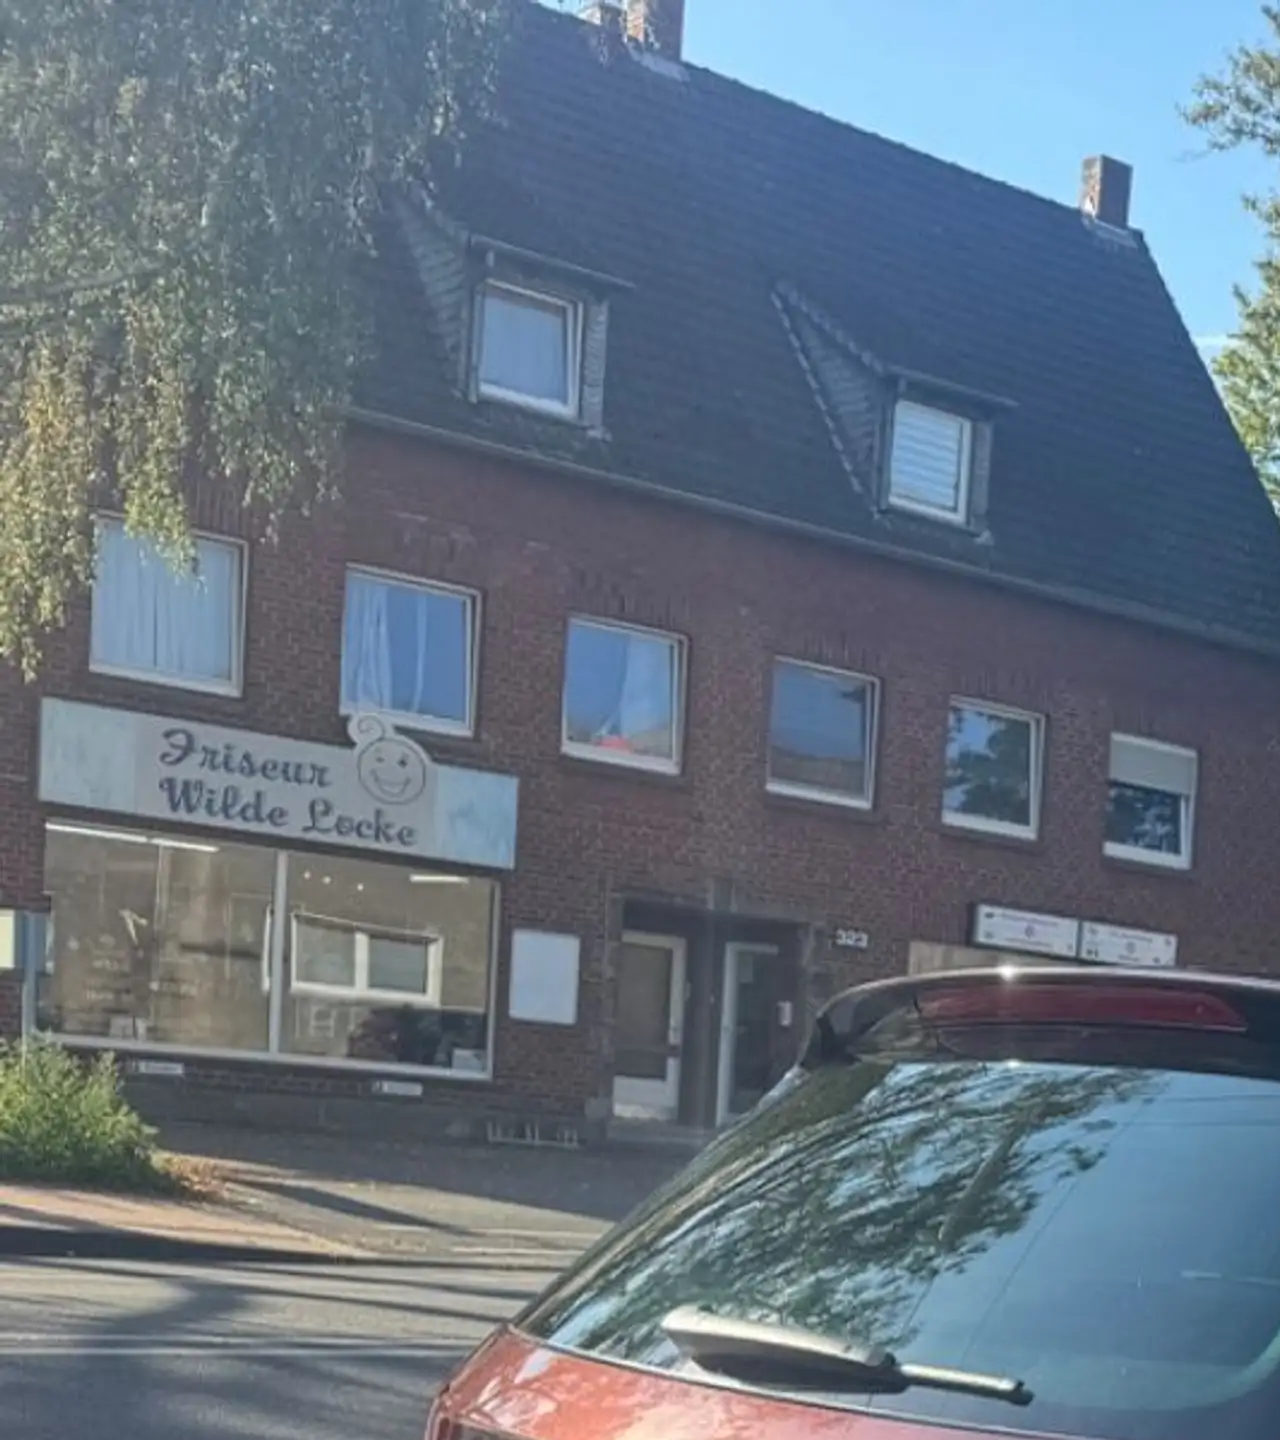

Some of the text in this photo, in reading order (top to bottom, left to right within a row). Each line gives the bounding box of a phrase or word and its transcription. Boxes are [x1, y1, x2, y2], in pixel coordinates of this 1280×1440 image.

[159, 727, 333, 788] Friseur
[158, 776, 419, 847] Wilde Locke
